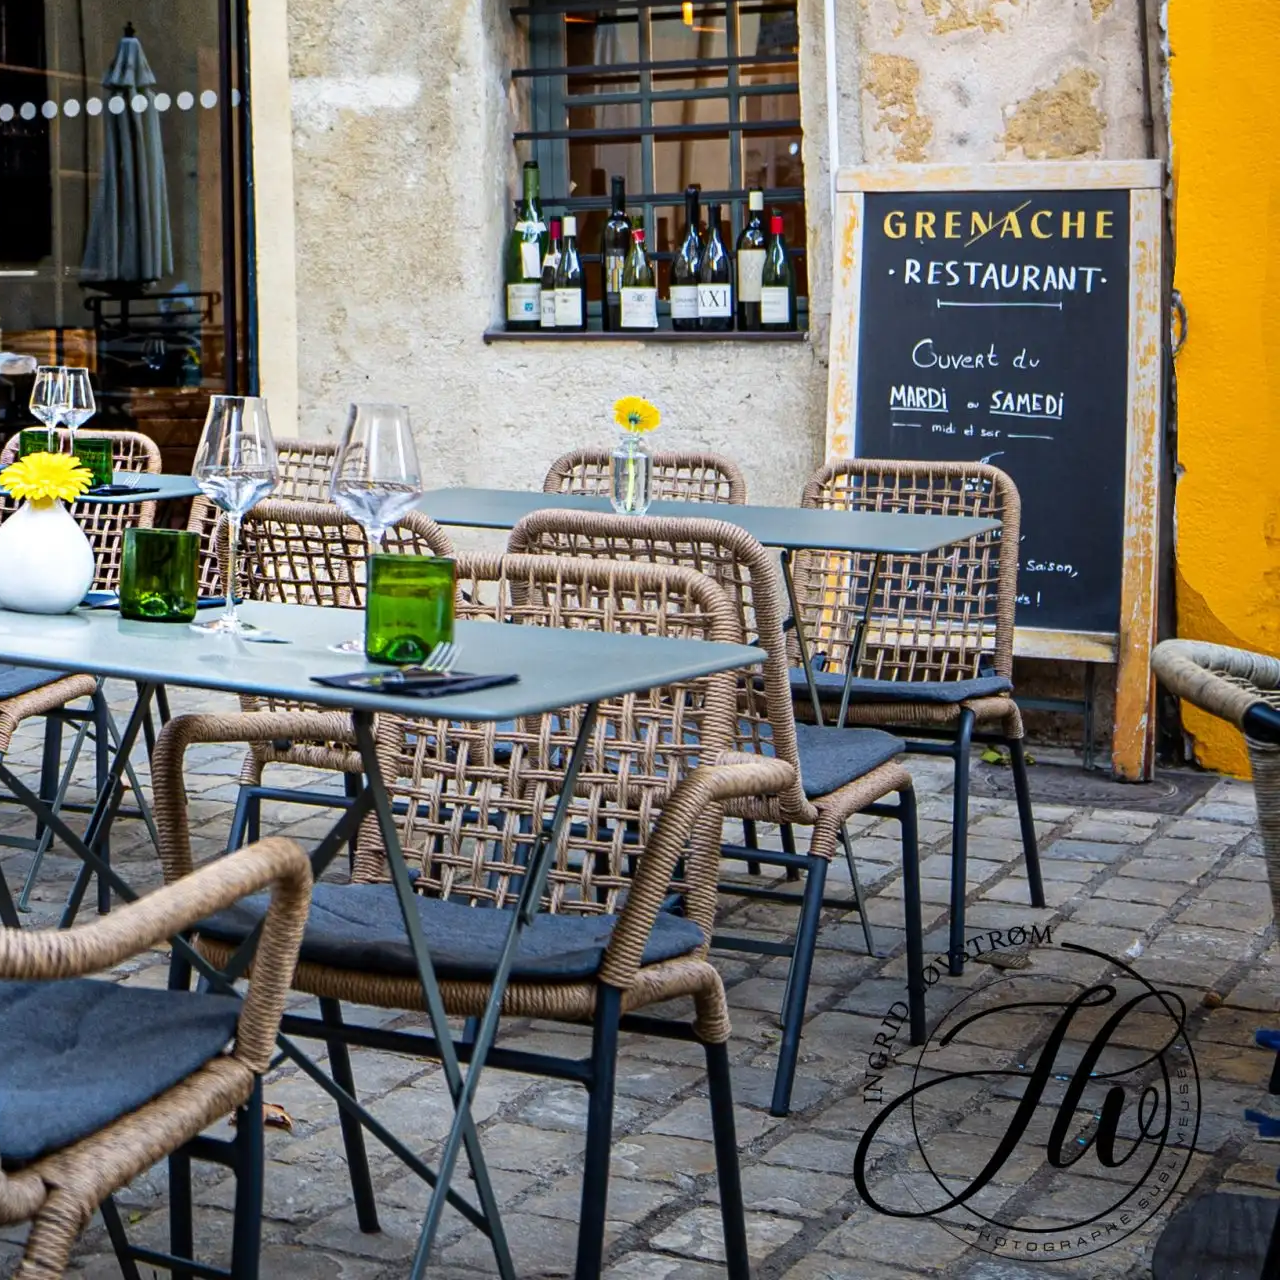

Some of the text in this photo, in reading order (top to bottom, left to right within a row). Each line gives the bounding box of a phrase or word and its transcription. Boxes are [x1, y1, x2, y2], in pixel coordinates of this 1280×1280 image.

[883, 200, 1115, 247] GRENACHE
[1012, 348, 1041, 369] du
[931, 422, 957, 435] midi
[963, 424, 974, 437] et
